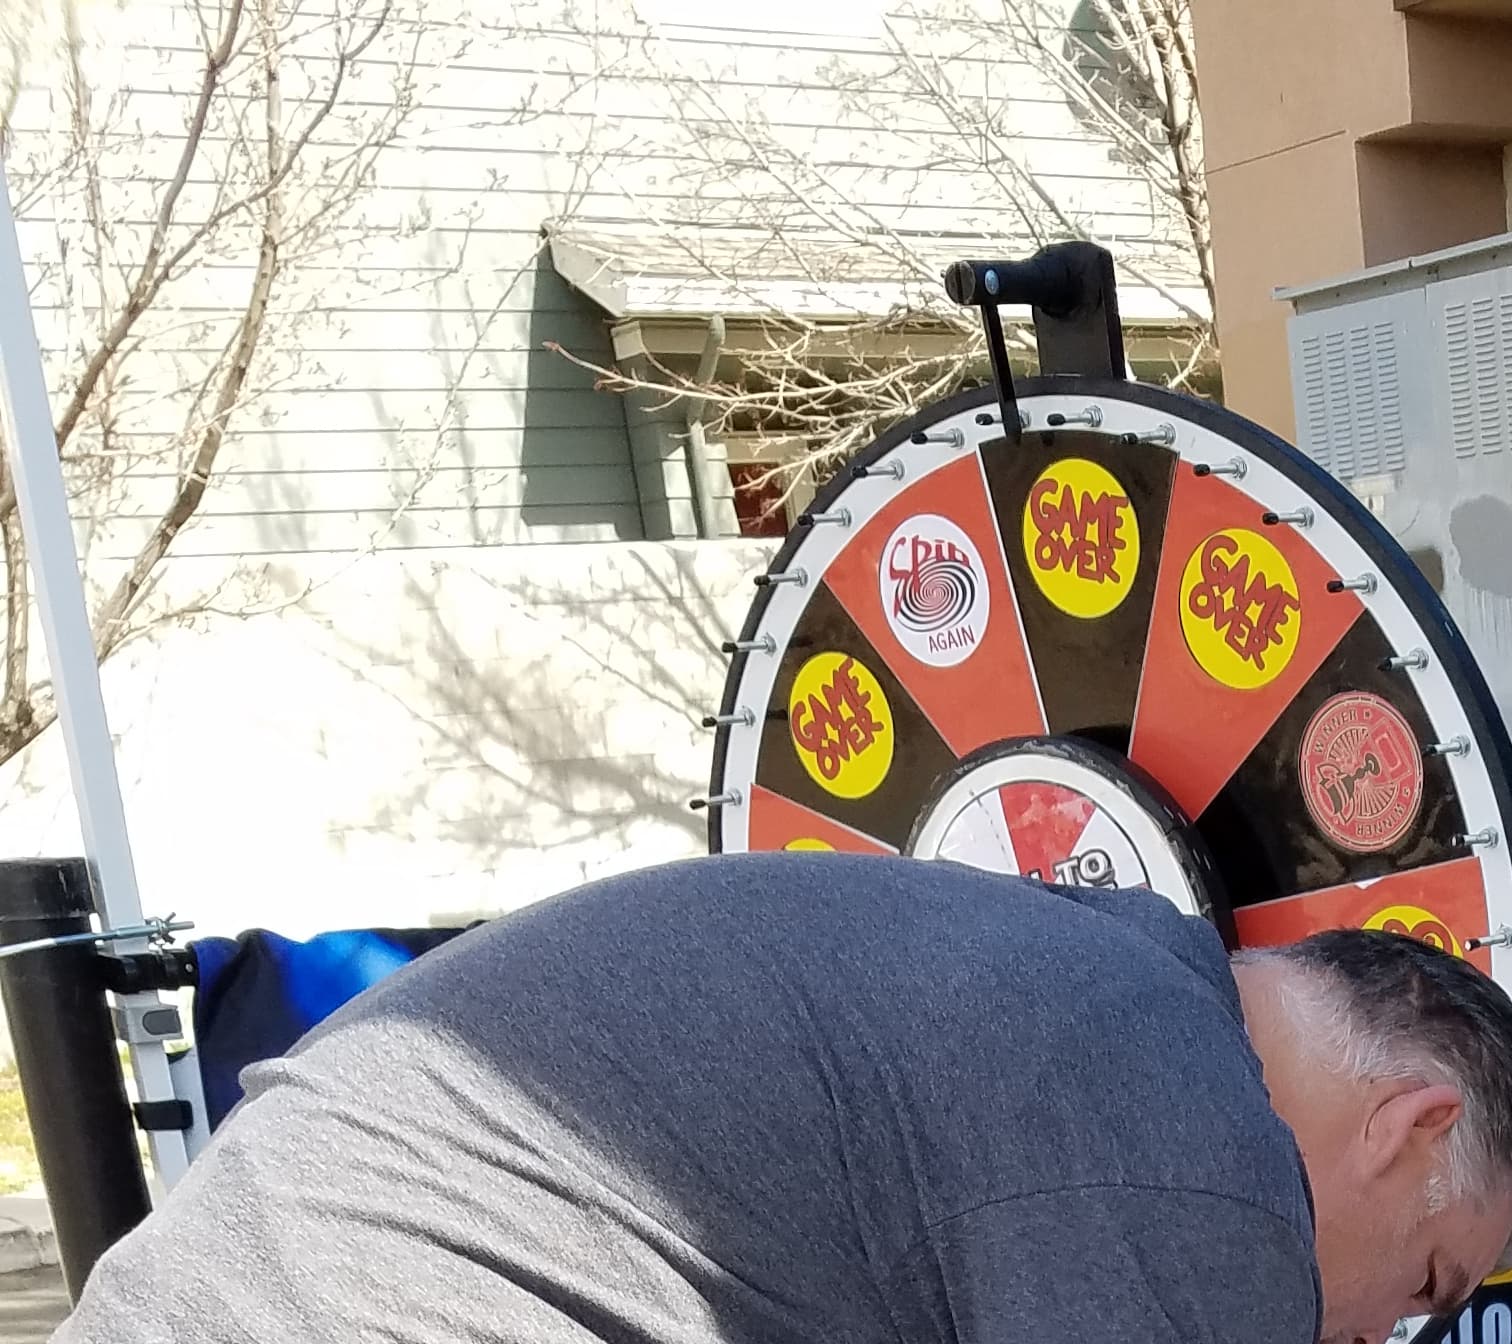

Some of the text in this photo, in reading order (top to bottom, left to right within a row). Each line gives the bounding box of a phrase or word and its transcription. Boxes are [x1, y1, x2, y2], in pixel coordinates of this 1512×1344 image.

[1031, 478, 1129, 549] GAME
[1035, 533, 1121, 583] OVER
[1201, 535, 1299, 645] GAME
[927, 624, 976, 654] AGAIN
[1189, 582, 1265, 671] OVER
[791, 657, 872, 751] GAME
[1314, 708, 1358, 754] WINNER
[816, 702, 884, 780] OVER
[1356, 803, 1406, 837] WINNER
